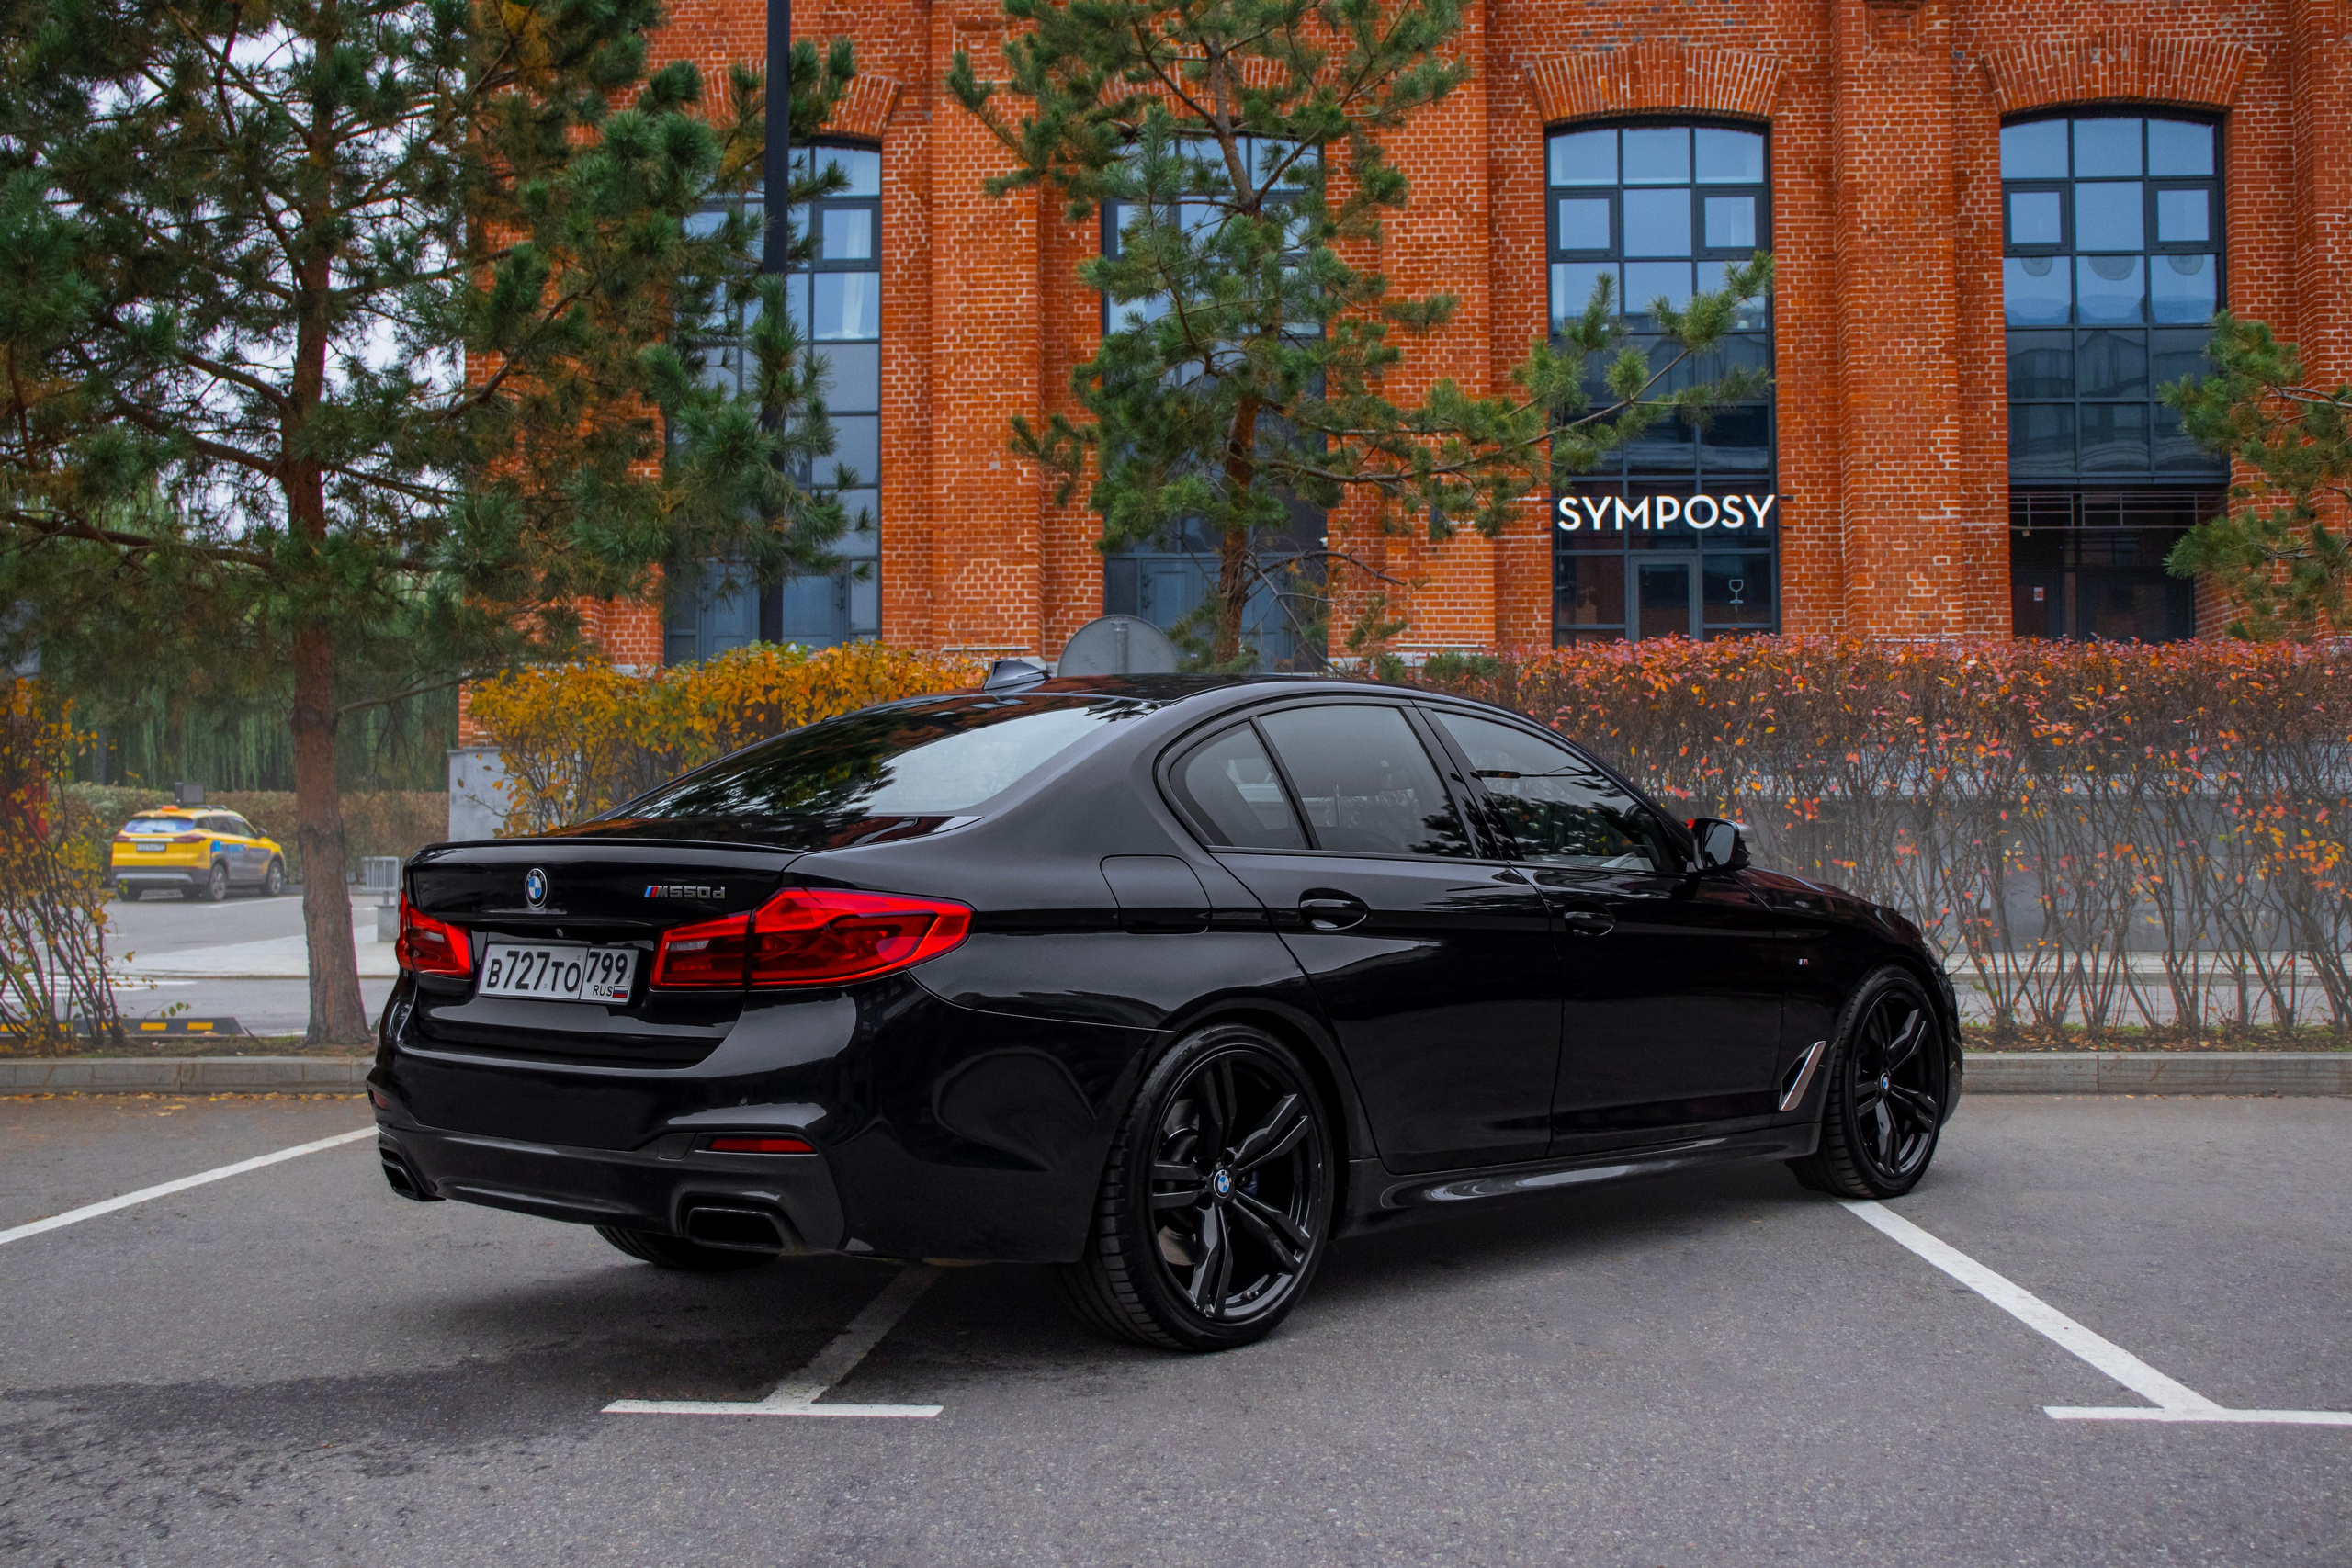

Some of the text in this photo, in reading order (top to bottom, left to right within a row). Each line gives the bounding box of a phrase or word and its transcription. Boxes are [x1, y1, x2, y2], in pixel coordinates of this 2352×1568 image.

[1557, 494, 1776, 531] SYMPOSY
[654, 886, 726, 899] M550d
[586, 951, 628, 985] 799
[592, 985, 613, 998] RUS
